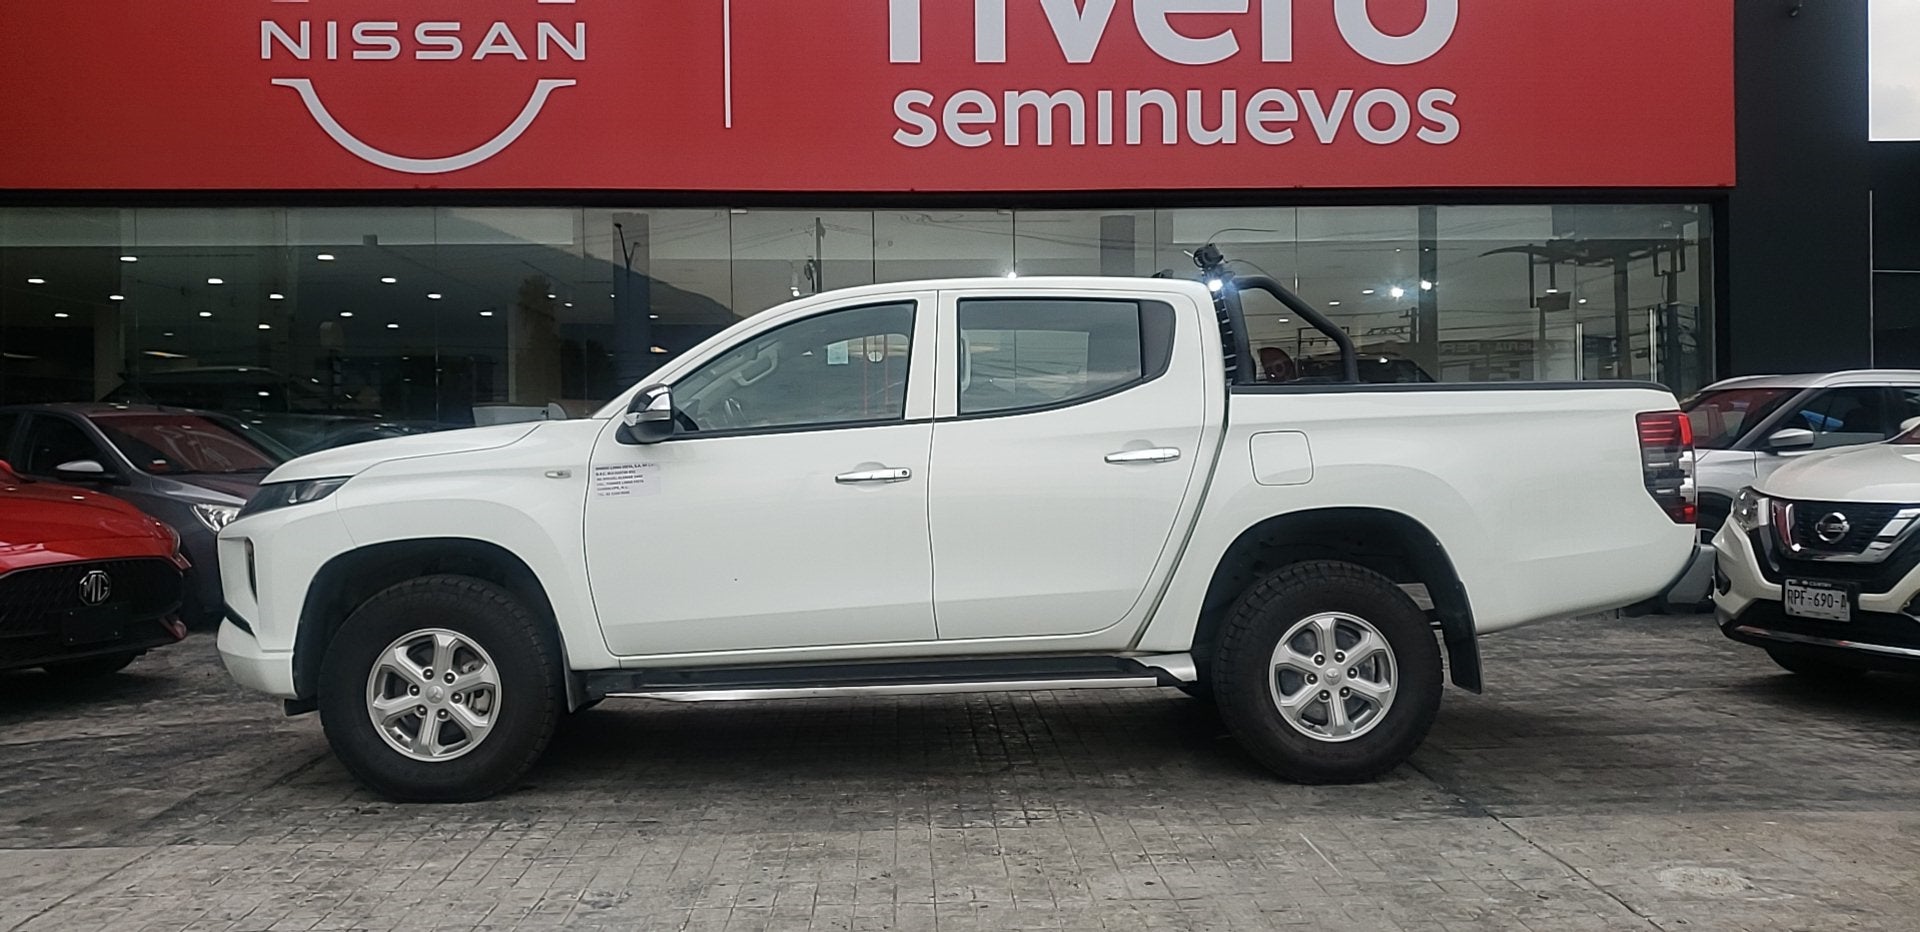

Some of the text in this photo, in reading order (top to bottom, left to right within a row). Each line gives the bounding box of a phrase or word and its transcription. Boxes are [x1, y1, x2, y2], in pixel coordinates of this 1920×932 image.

[261, 21, 586, 60] NISSAN
[892, 88, 1460, 147] seminuevos
[83, 574, 109, 602] MG
[1787, 589, 1847, 610] RPF-690-A
